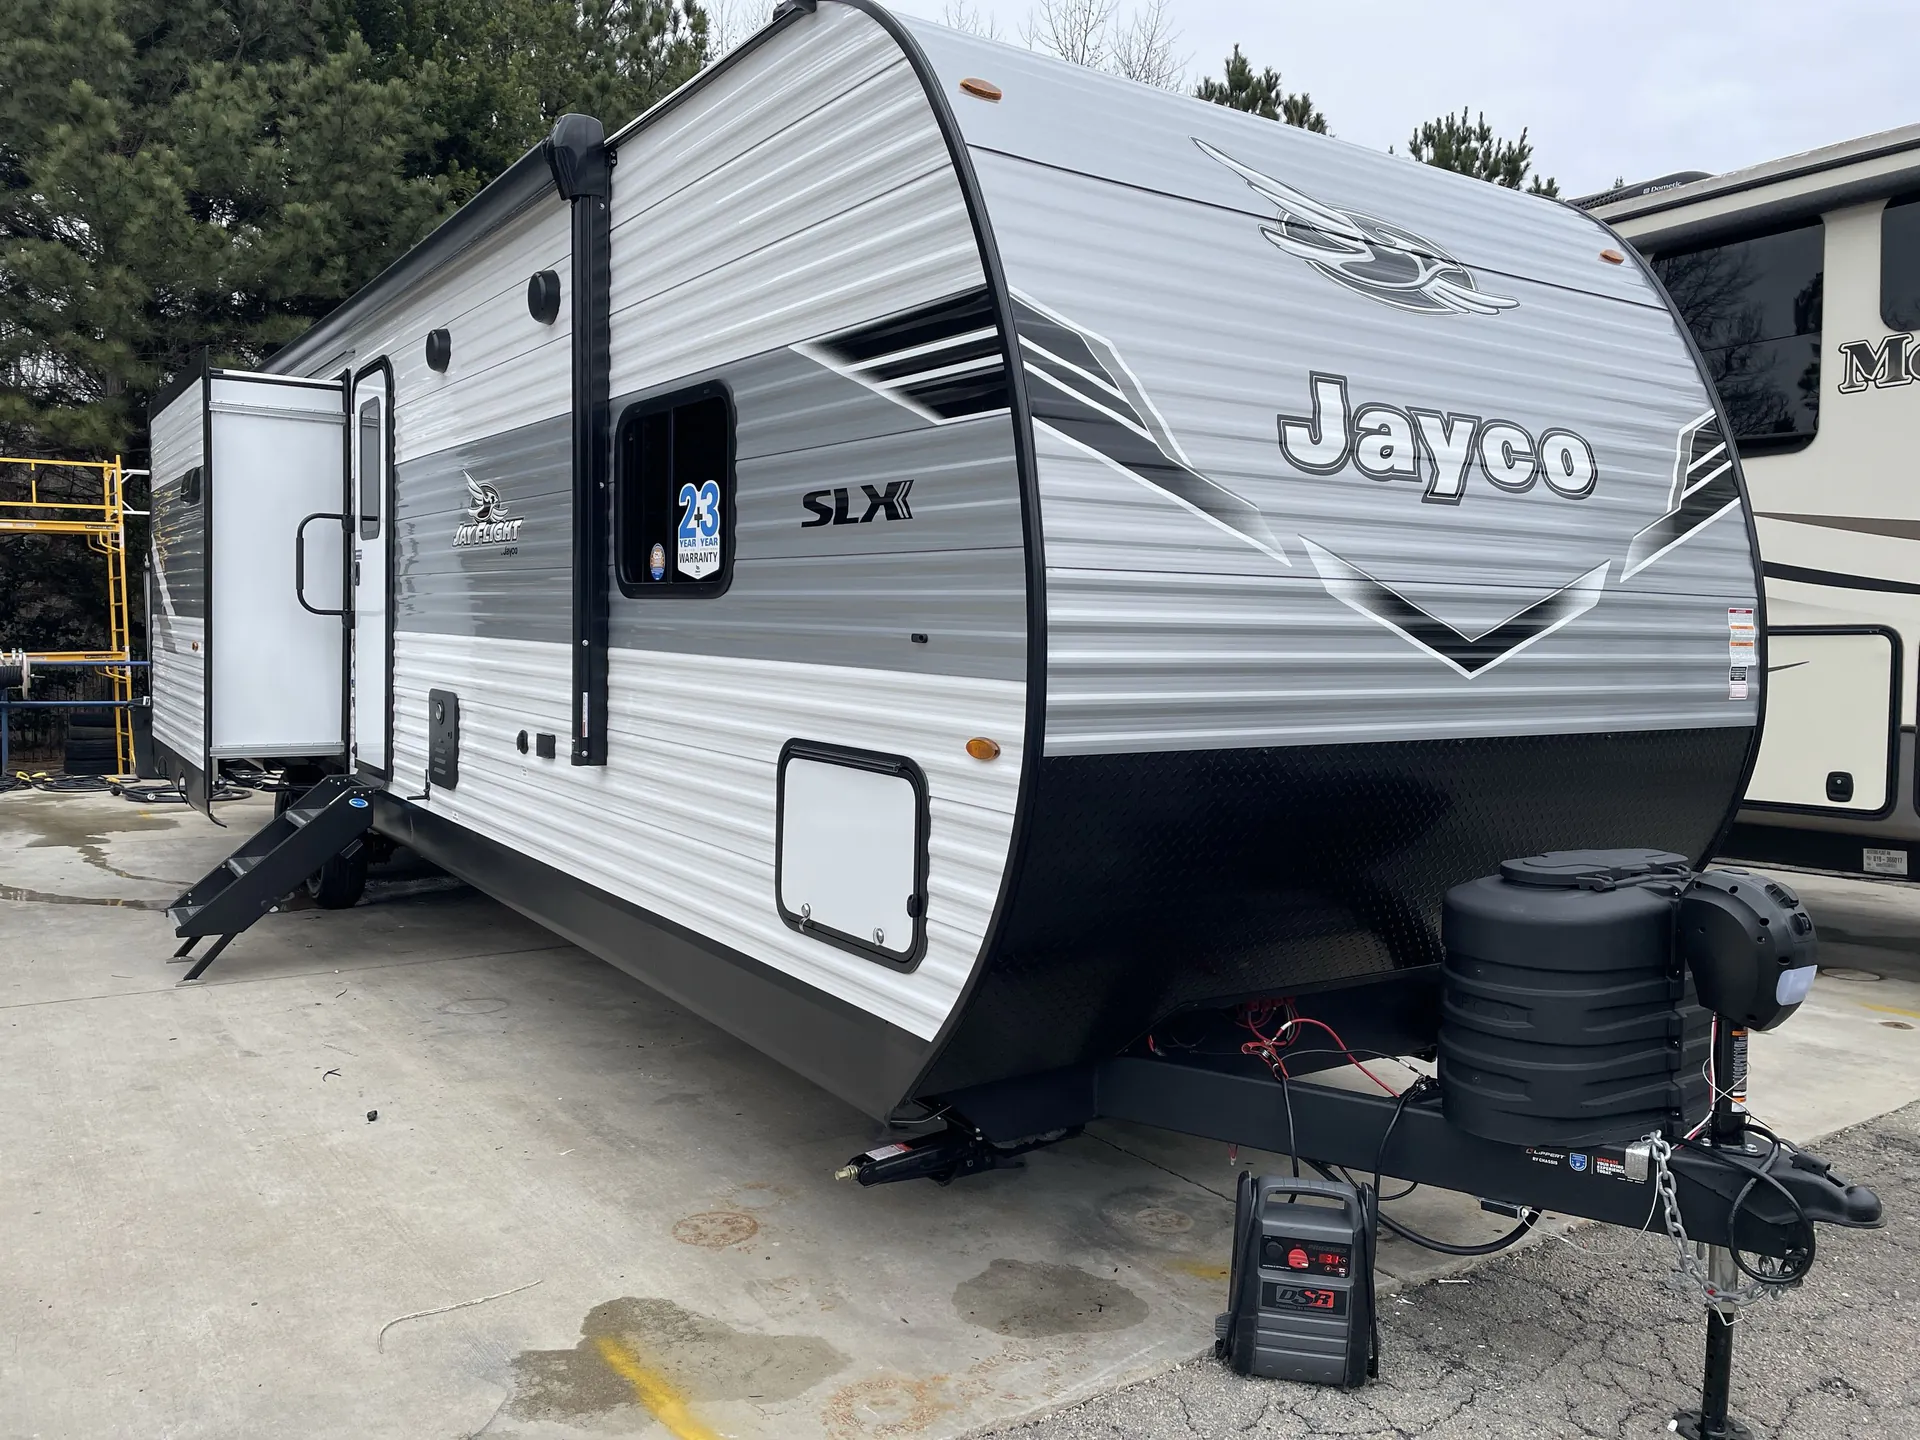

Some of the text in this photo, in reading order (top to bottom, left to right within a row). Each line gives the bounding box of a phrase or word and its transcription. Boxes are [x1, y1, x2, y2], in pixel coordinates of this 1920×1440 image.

[1277, 371, 1598, 506] Jayco
[801, 480, 914, 527] SLX
[452, 517, 525, 547] JAY FLIGHT
[680, 538, 719, 548] YEAR YEAR
[680, 552, 719, 564] WARRANTY
[1278, 1287, 1333, 1306] DSR
